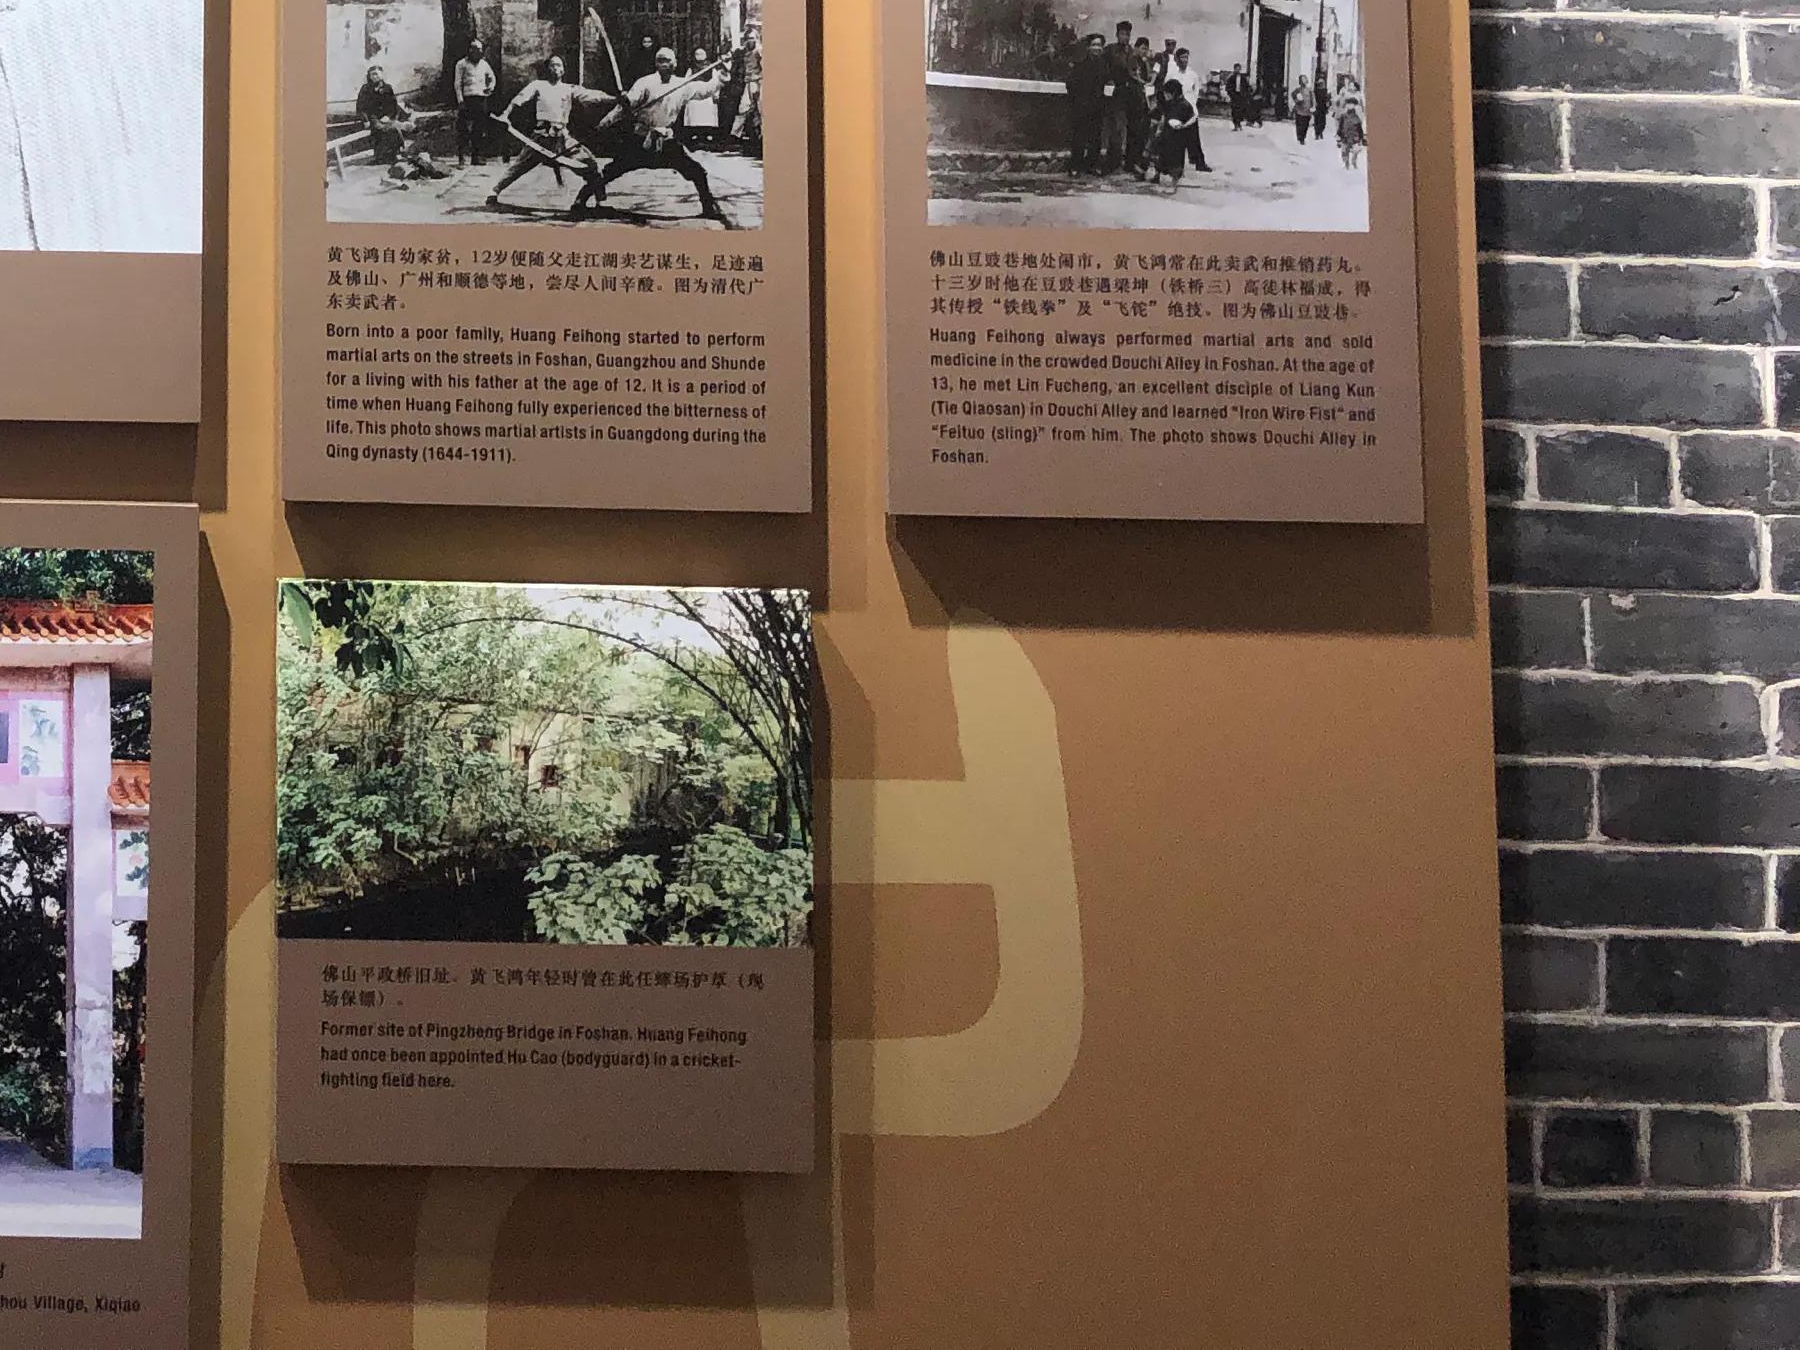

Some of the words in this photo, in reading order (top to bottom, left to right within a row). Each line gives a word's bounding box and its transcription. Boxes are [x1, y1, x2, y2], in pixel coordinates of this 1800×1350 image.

[326, 322, 360, 338] Born
[367, 323, 395, 338] into
[401, 327, 410, 339] a
[416, 328, 449, 342] poor
[455, 325, 504, 344] family,
[510, 327, 556, 346] Huang
[563, 328, 621, 347] Feihong
[628, 331, 680, 345] started
[686, 331, 700, 346] to
[707, 331, 765, 349] perform
[930, 327, 976, 346] Huang
[986, 328, 1045, 347] Feihong
[1055, 329, 1106, 348] always
[1116, 331, 1192, 349] performed
[1203, 332, 1255, 347] martial
[1265, 334, 1294, 348] arts
[1305, 335, 1332, 349] and
[1342, 335, 1373, 349] sold
[326, 347, 377, 362] martial
[381, 349, 410, 363] arts
[414, 351, 431, 363] on
[435, 349, 459, 364] the
[463, 350, 513, 366] streets
[518, 351, 531, 366] in
[535, 351, 592, 369] Foshan,
[596, 353, 676, 371] Guangzhou
[680, 355, 707, 370] and
[711, 355, 766, 371] Shunde
[932, 376, 954, 393] 13,
[959, 376, 977, 392] he
[983, 378, 1011, 392] met
[1017, 377, 1039, 392] Lin
[1046, 377, 1112, 396] Fucheng,
[1118, 381, 1136, 394] an
[1142, 380, 1209, 395] excellent
[1215, 380, 1273, 398] disciple
[1279, 382, 1293, 397] of
[1300, 382, 1341, 400] Liang
[1346, 382, 1375, 398] Kun
[326, 443, 359, 462] Qing
[362, 445, 419, 463] dynasty
[422, 446, 516, 464] (1644-1911).
[932, 448, 989, 464] Foshan.
